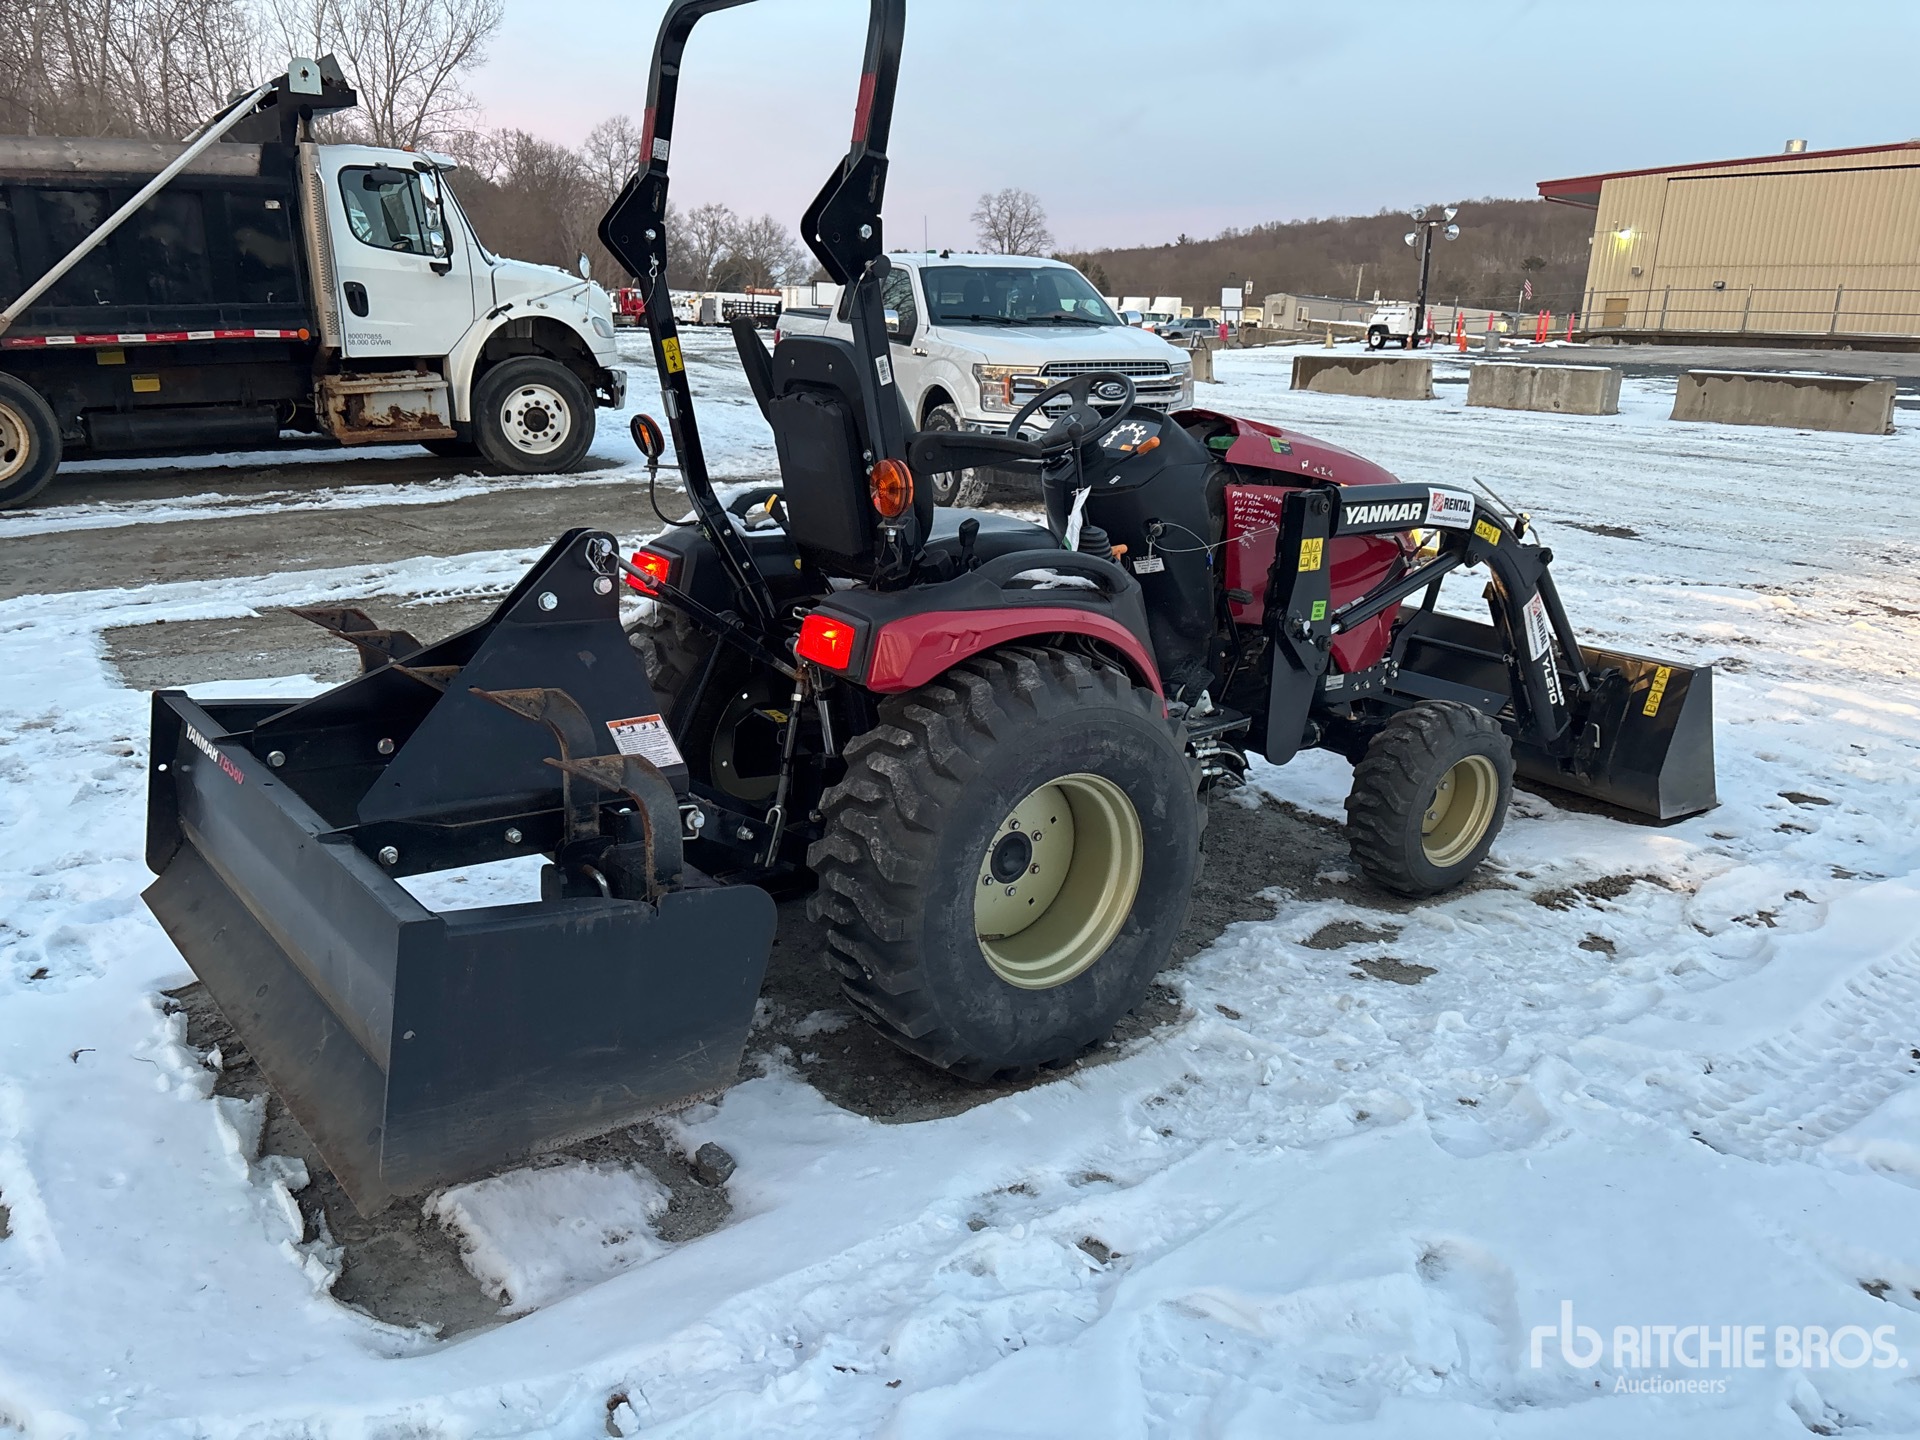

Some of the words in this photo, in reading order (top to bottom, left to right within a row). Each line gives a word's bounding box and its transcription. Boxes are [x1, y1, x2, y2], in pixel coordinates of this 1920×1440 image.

[1345, 502, 1423, 525] YANMAR
[1443, 497, 1471, 513] RENTAL
[1535, 611, 1548, 650] RENTAL
[1542, 656, 1558, 705] YL210
[186, 722, 219, 763] YANMAR
